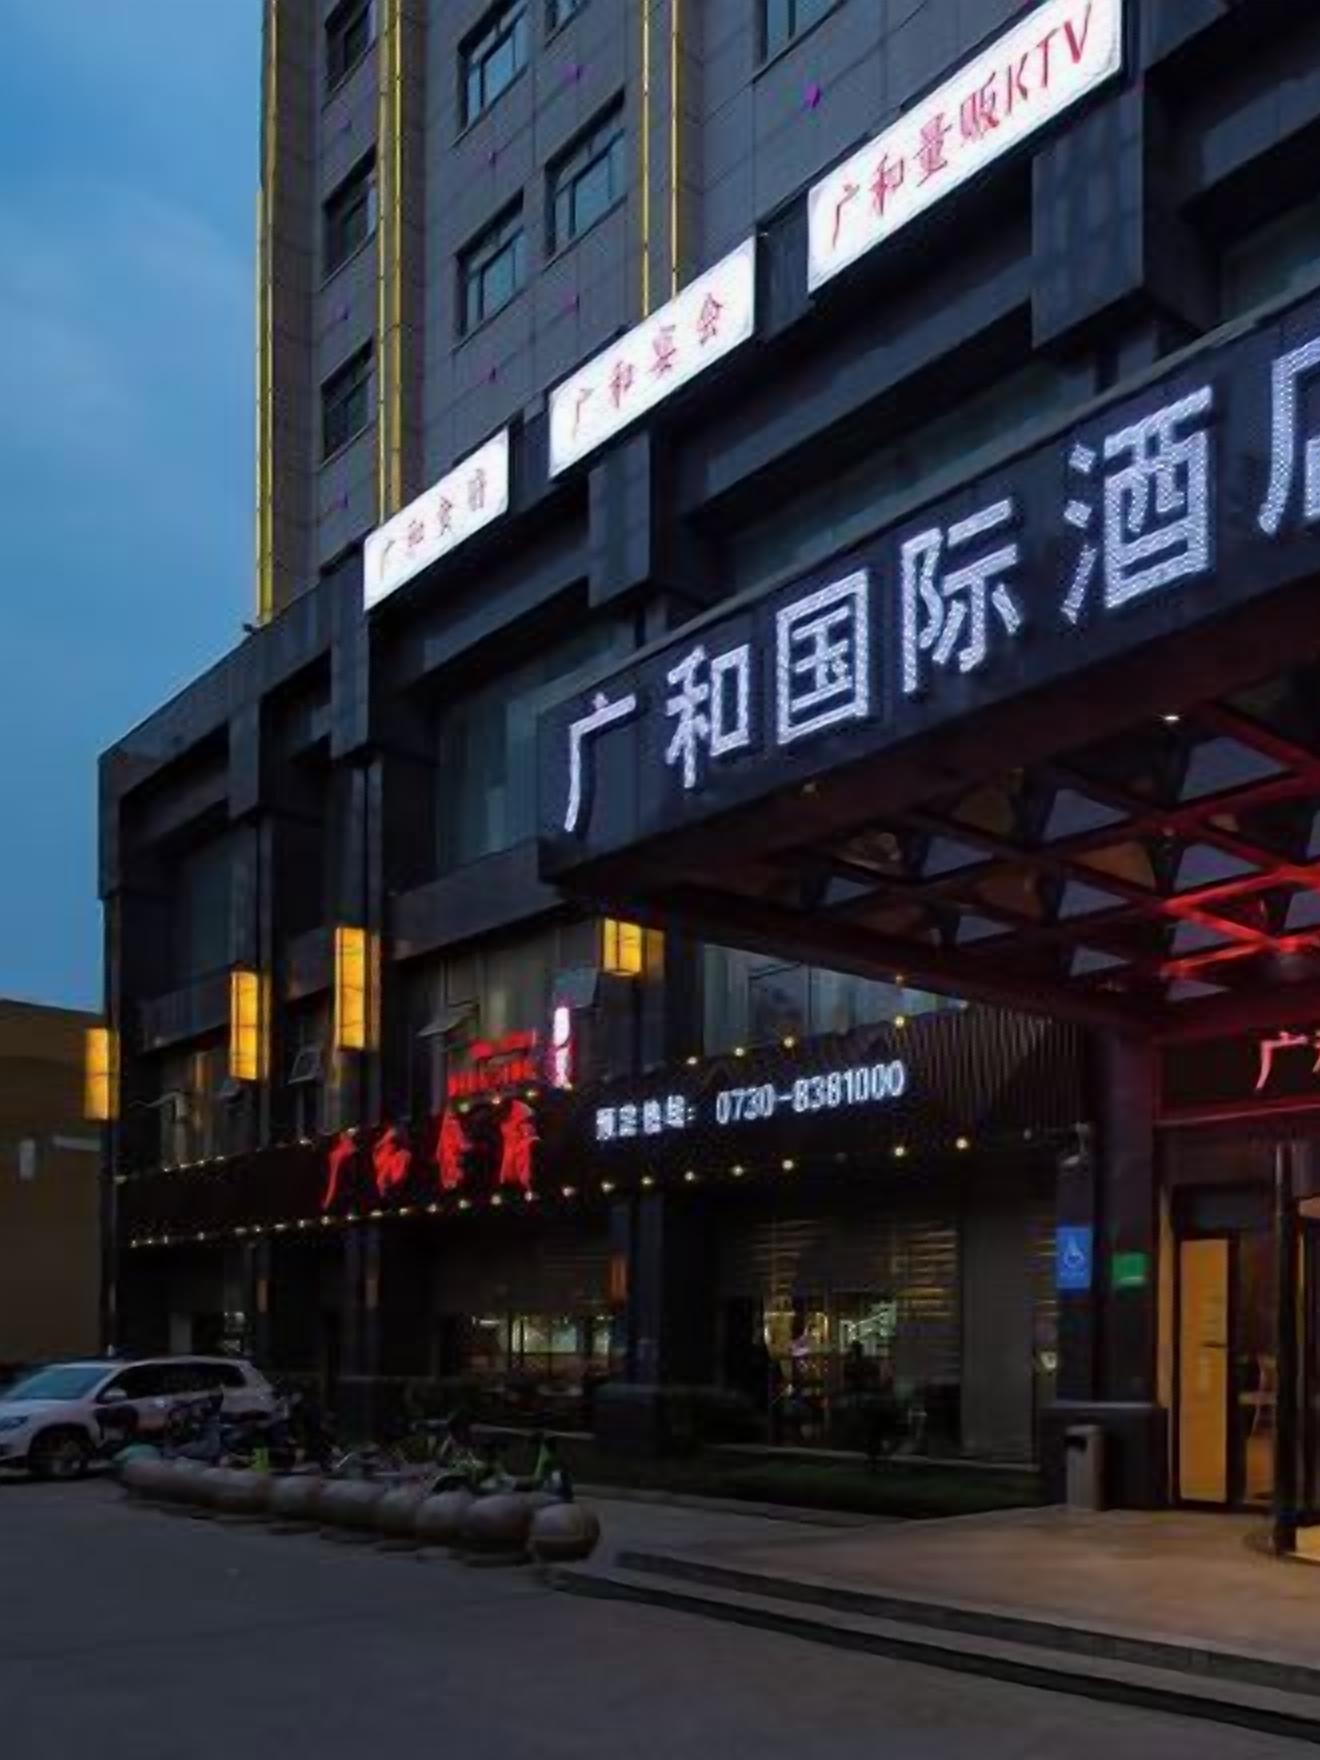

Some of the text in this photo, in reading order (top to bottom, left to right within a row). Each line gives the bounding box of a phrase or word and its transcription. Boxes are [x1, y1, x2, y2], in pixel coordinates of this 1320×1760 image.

[833, 0, 1092, 249] 广和量贩KTV
[716, 1059, 905, 1126] 0730-8381000
